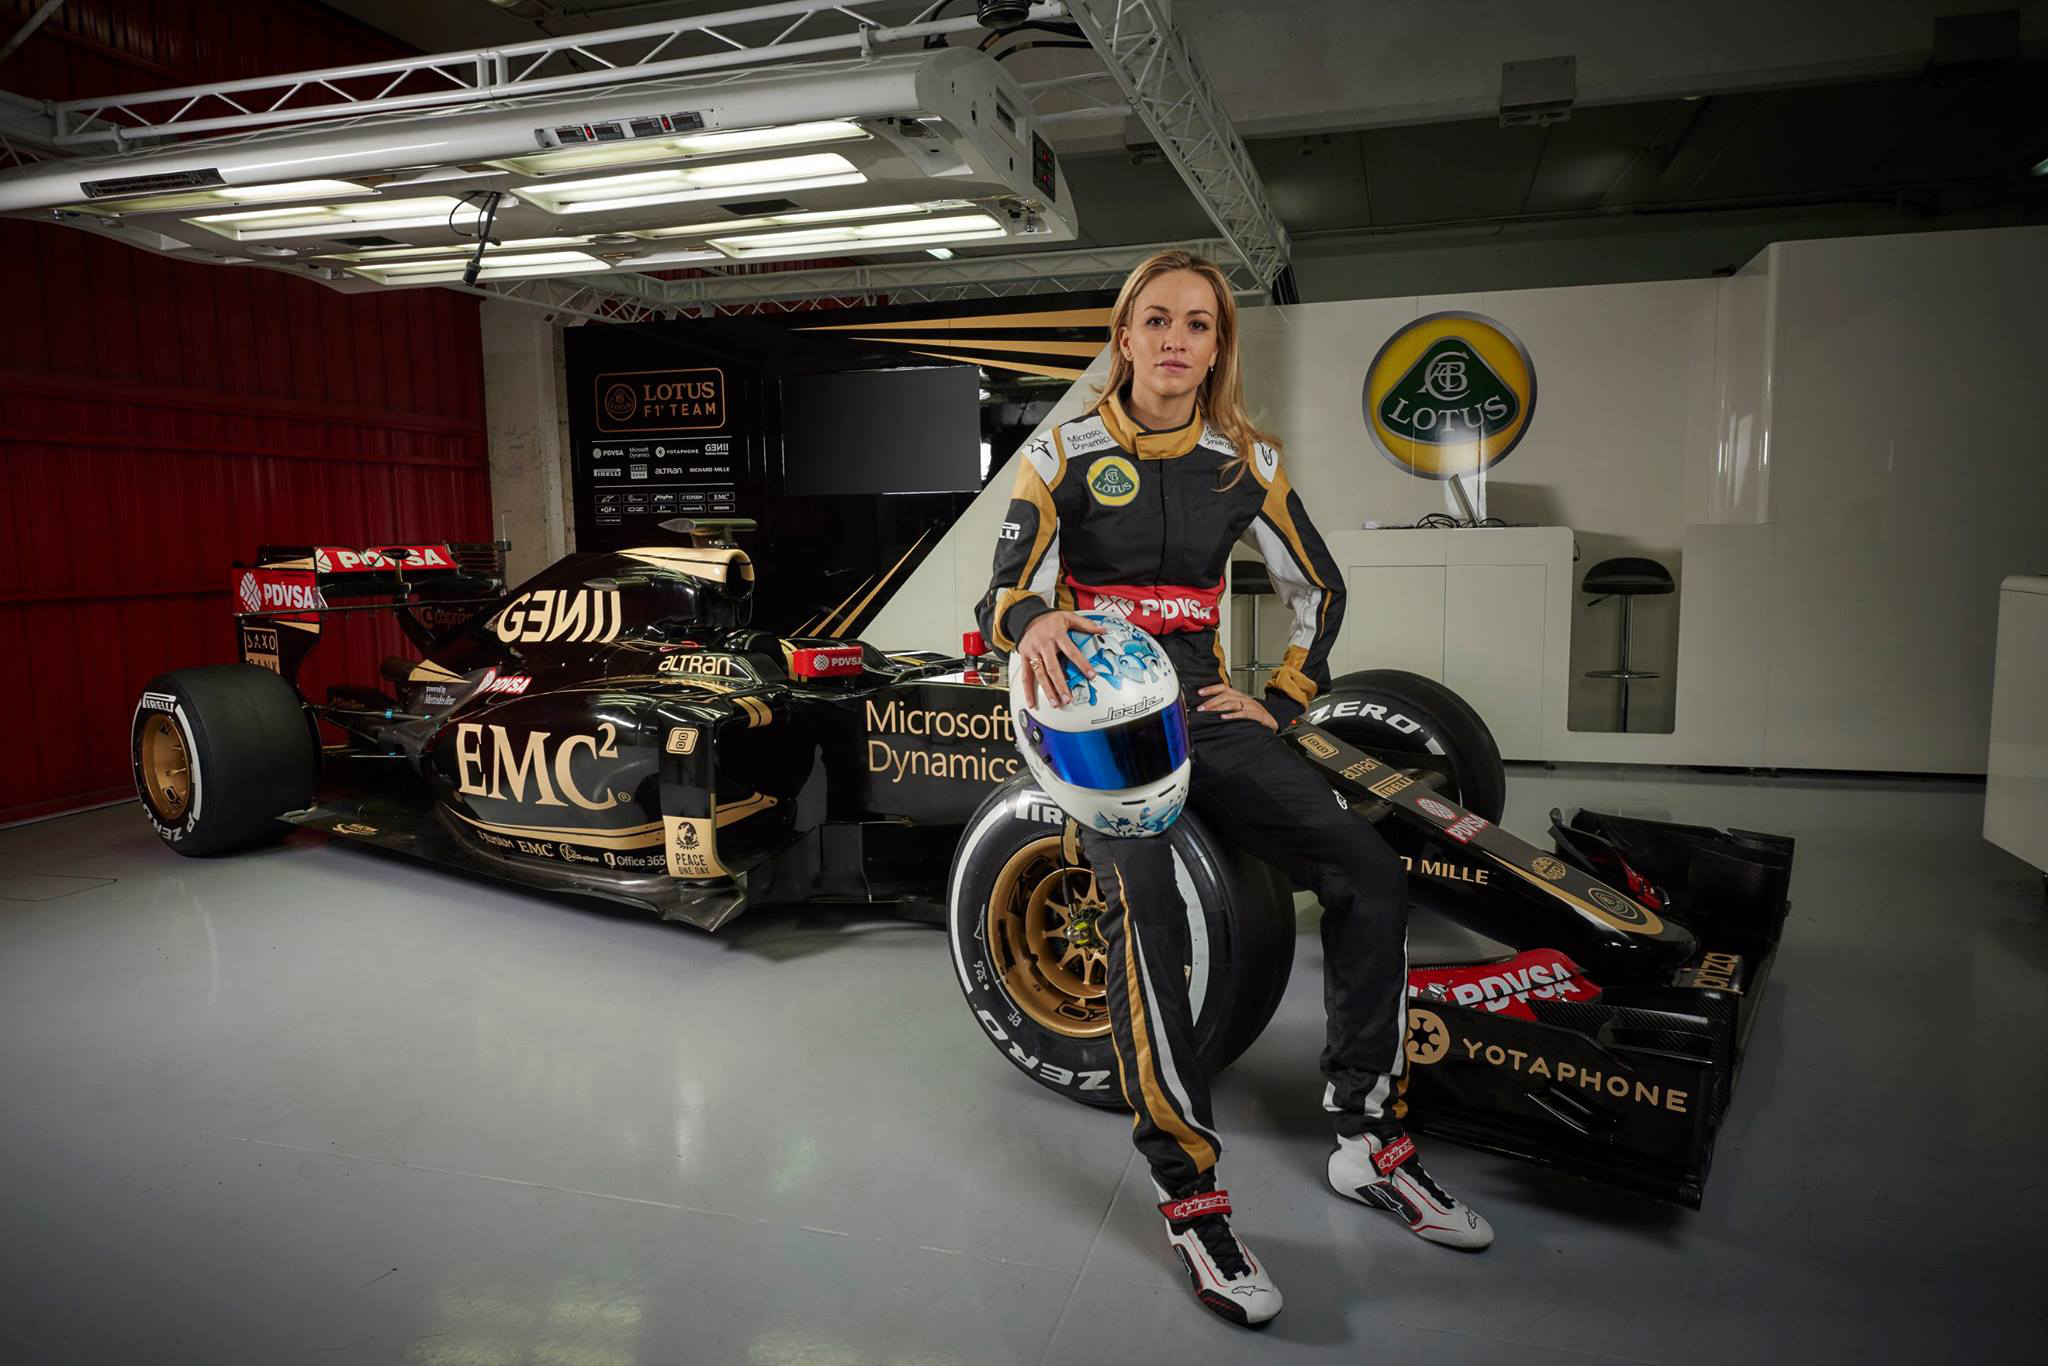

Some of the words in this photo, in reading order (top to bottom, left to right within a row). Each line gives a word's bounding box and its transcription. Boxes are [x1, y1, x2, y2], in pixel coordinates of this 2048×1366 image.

[643, 381, 715, 401] LOTUS
[670, 402, 716, 417] TEAM
[1388, 394, 1509, 432] LOTUS
[1067, 429, 1103, 443] Microso
[1095, 479, 1133, 494] LOTUS
[263, 582, 317, 609] PDVSA
[247, 633, 277, 651] SAXO
[831, 657, 863, 667] PDVSA
[487, 675, 533, 695] PDVSA
[142, 692, 177, 712] PIRELLI
[866, 699, 1016, 742] Microsoft
[1308, 700, 1422, 735] ZERO
[867, 739, 1019, 784] Dynamics
[1367, 772, 1416, 798] PIRELLI
[1449, 811, 1490, 842] PDVSA
[616, 855, 645, 867] Office
[646, 854, 666, 867] 365
[675, 853, 708, 867] PEACE
[678, 866, 693, 876] ONE
[1420, 859, 1490, 886] MILLE
[1454, 962, 1581, 1014] PDVSA
[977, 1009, 1112, 1091] ZERO
[1462, 1036, 1690, 1114] YOTAPHONE
